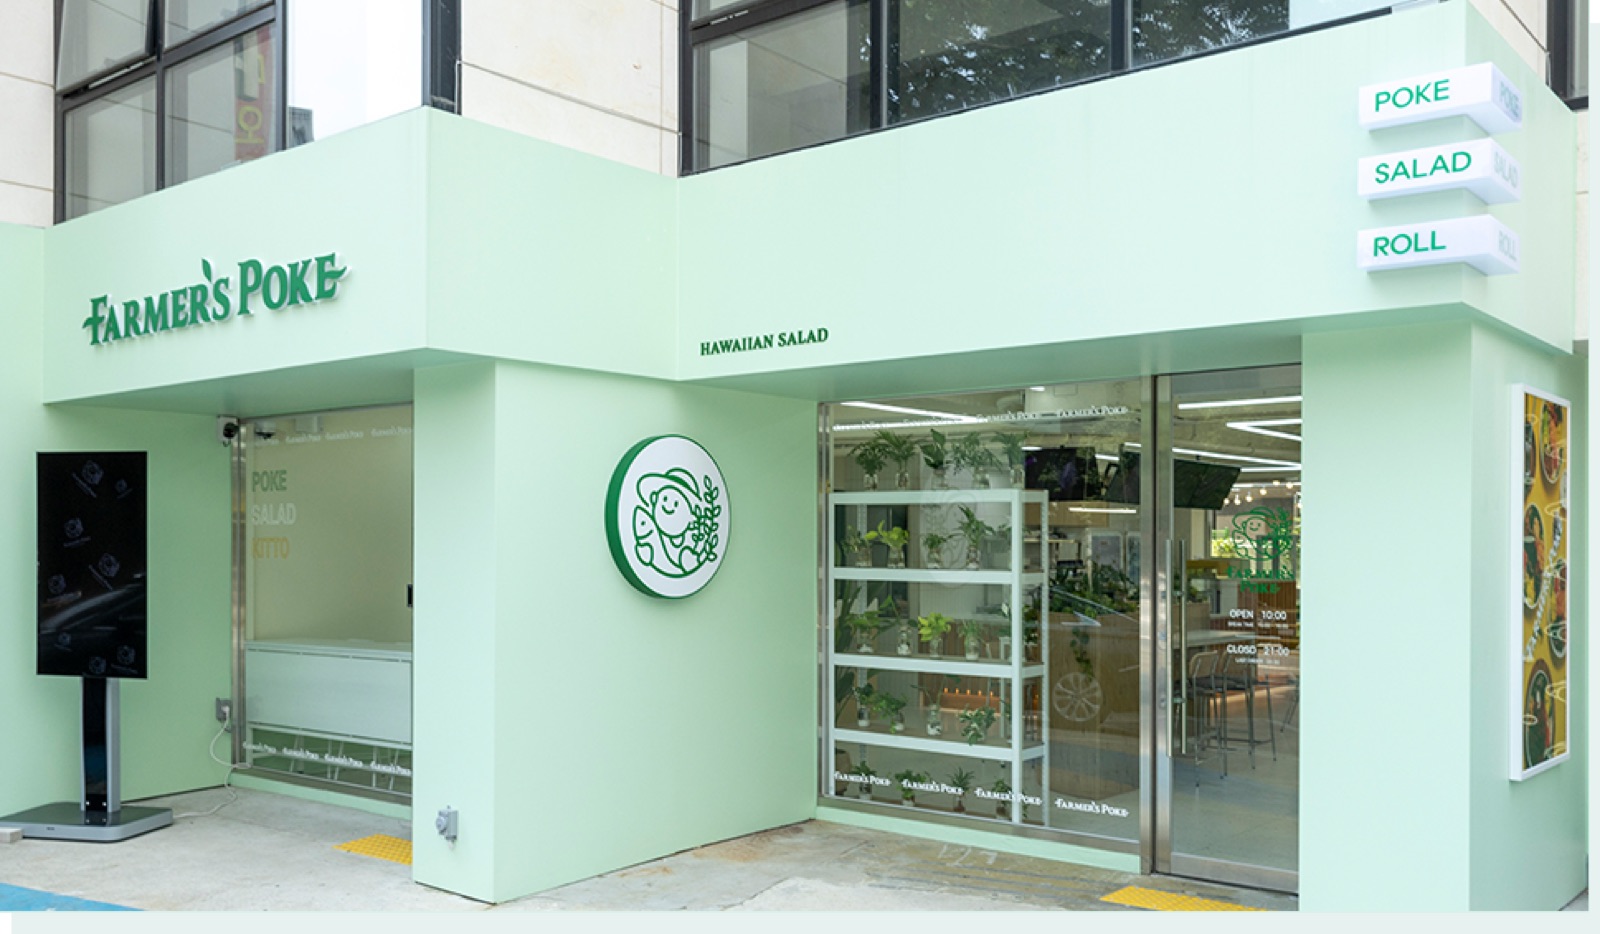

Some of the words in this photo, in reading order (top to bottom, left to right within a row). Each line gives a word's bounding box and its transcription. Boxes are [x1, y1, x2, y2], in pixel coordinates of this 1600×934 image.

[1374, 78, 1450, 113] POKE
[1374, 151, 1472, 184] SALAD
[1373, 230, 1447, 257] ROLL
[82, 257, 231, 346] FARMER'S
[237, 252, 348, 316] POKE
[700, 334, 774, 356] HAWAIIAN
[778, 327, 830, 348] SALAD
[252, 469, 287, 492] POKE
[251, 502, 297, 525] SALAD
[252, 536, 290, 559] KITTO
[1229, 608, 1254, 619] OPEN
[1054, 798, 1100, 813] FARMER'S
[1101, 803, 1129, 817] POKE
